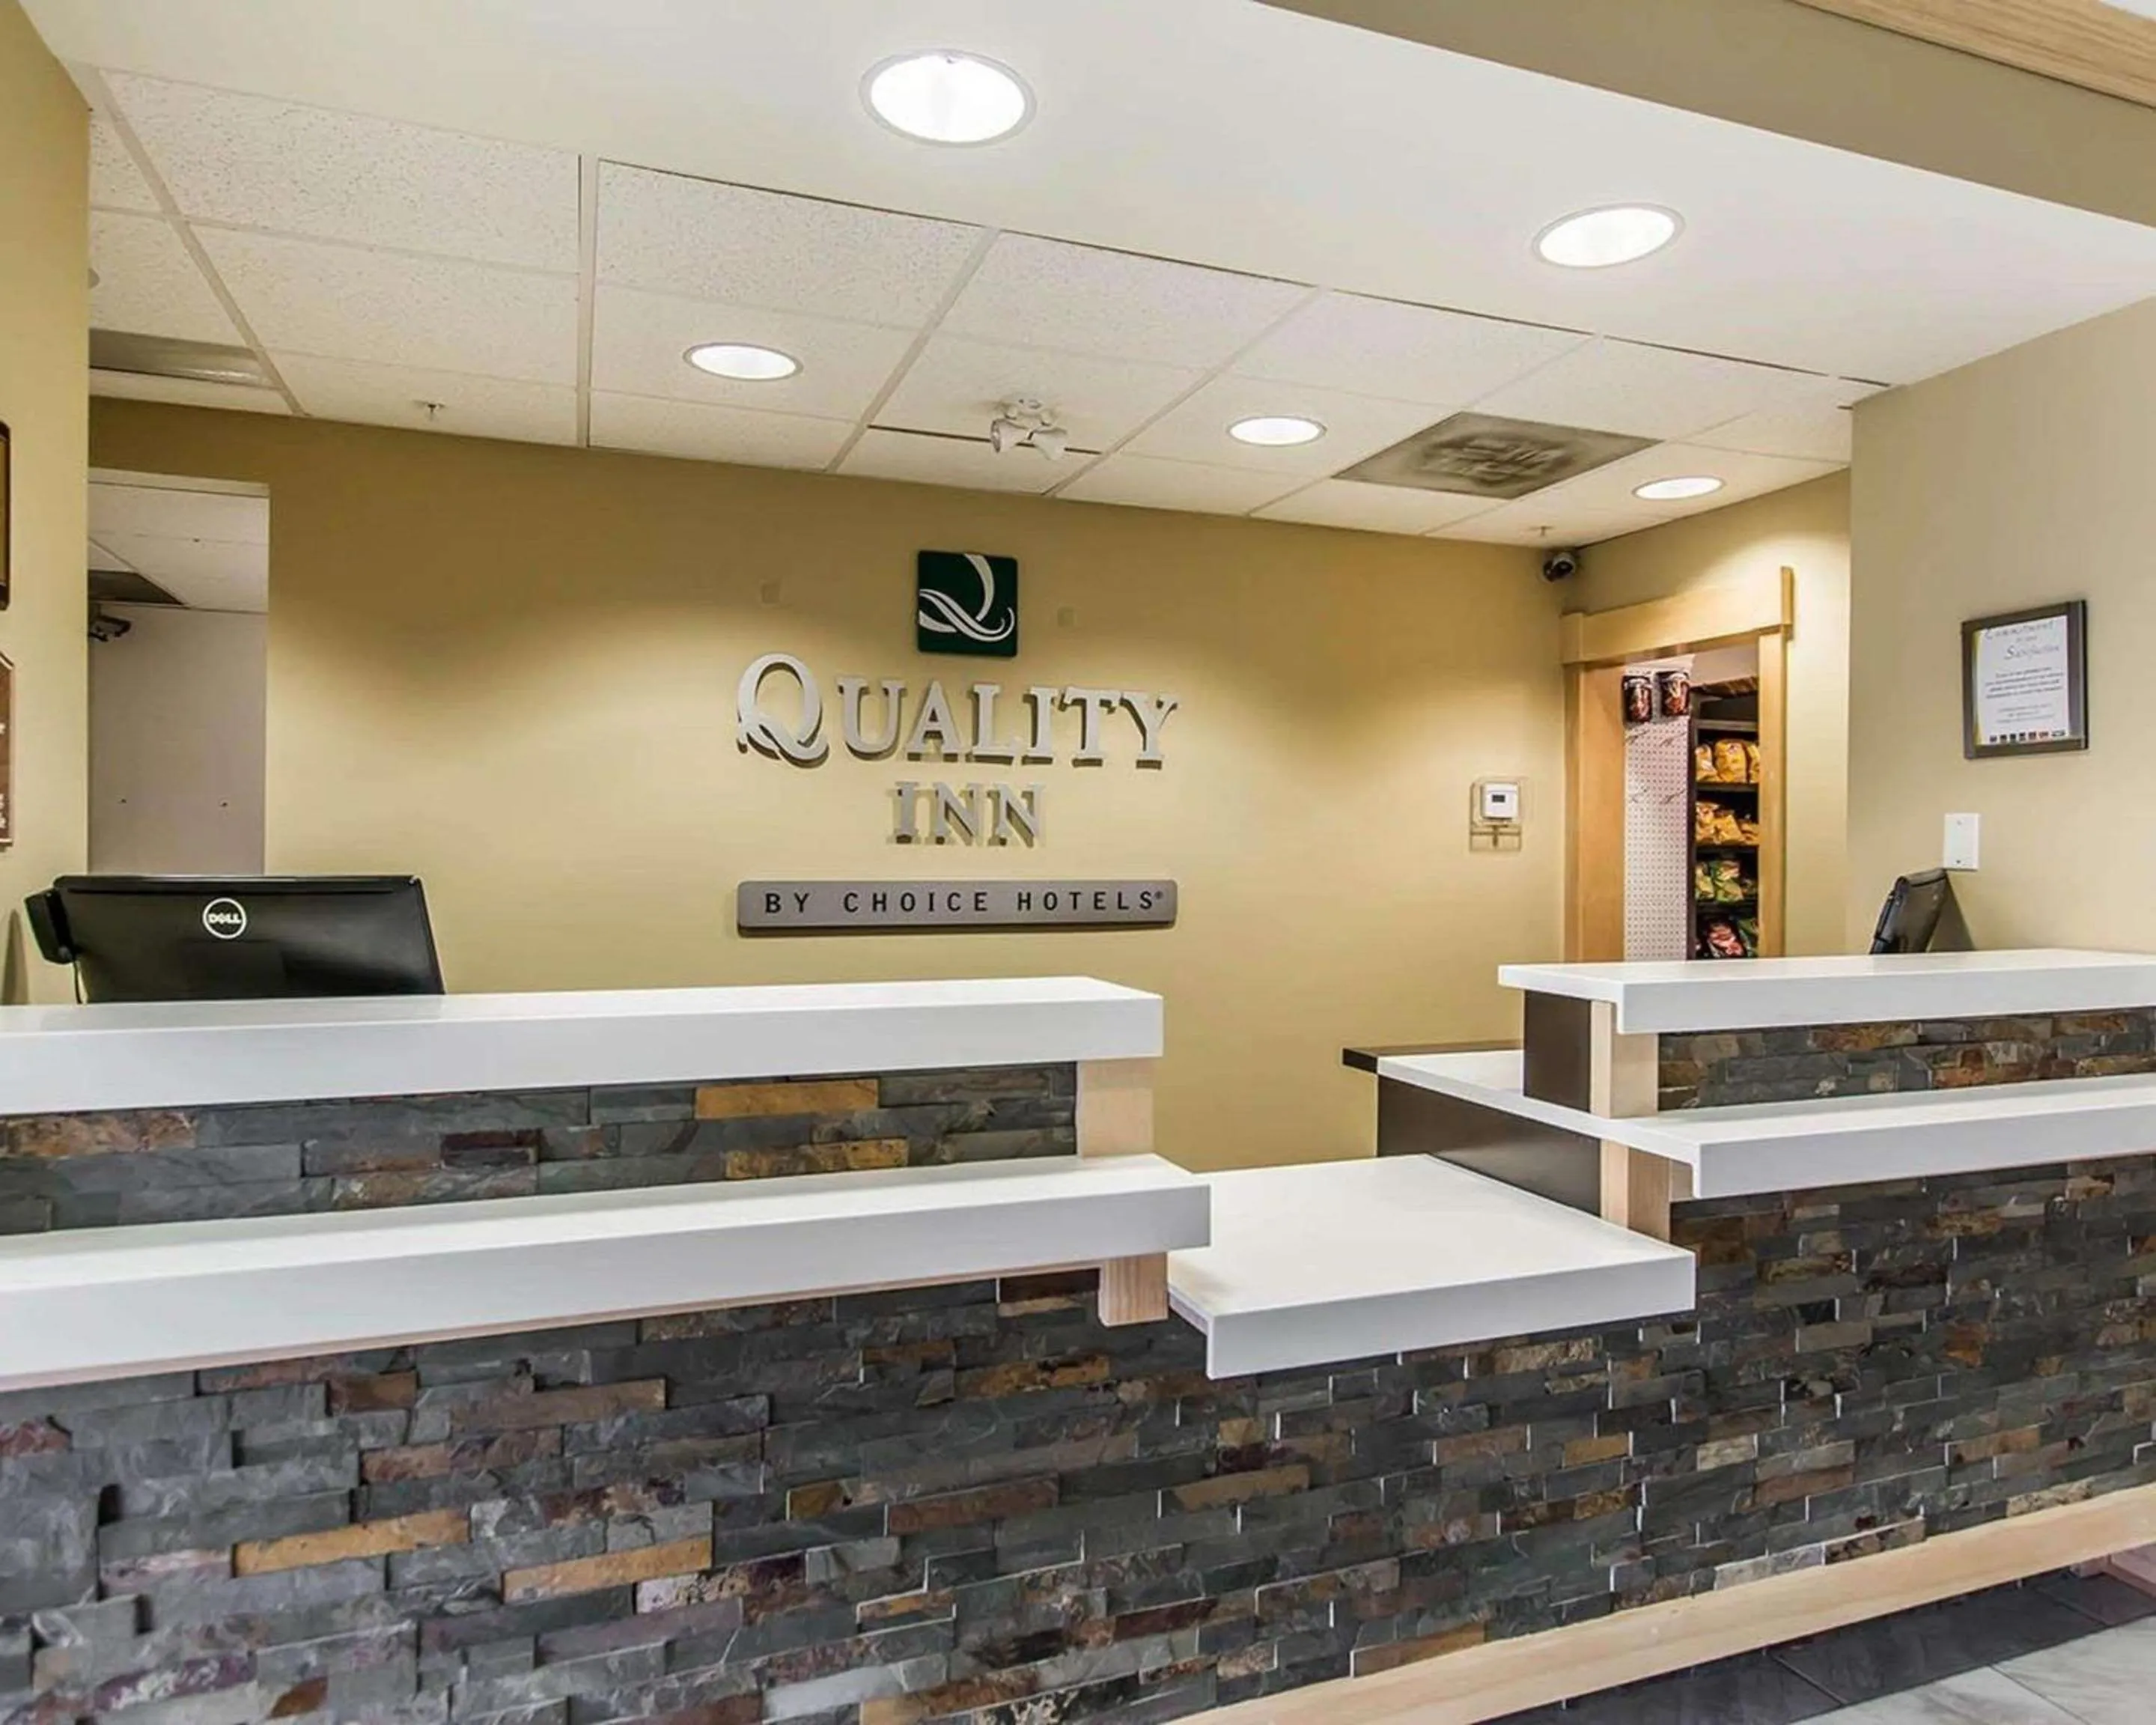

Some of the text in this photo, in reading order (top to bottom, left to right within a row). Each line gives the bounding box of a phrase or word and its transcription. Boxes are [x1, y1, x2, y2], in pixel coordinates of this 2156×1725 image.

[737, 653, 1180, 768] QUALITY
[889, 781, 1045, 847] INN
[208, 913, 242, 925] DELL
[764, 892, 809, 913] BY
[843, 891, 987, 913] CHOICE
